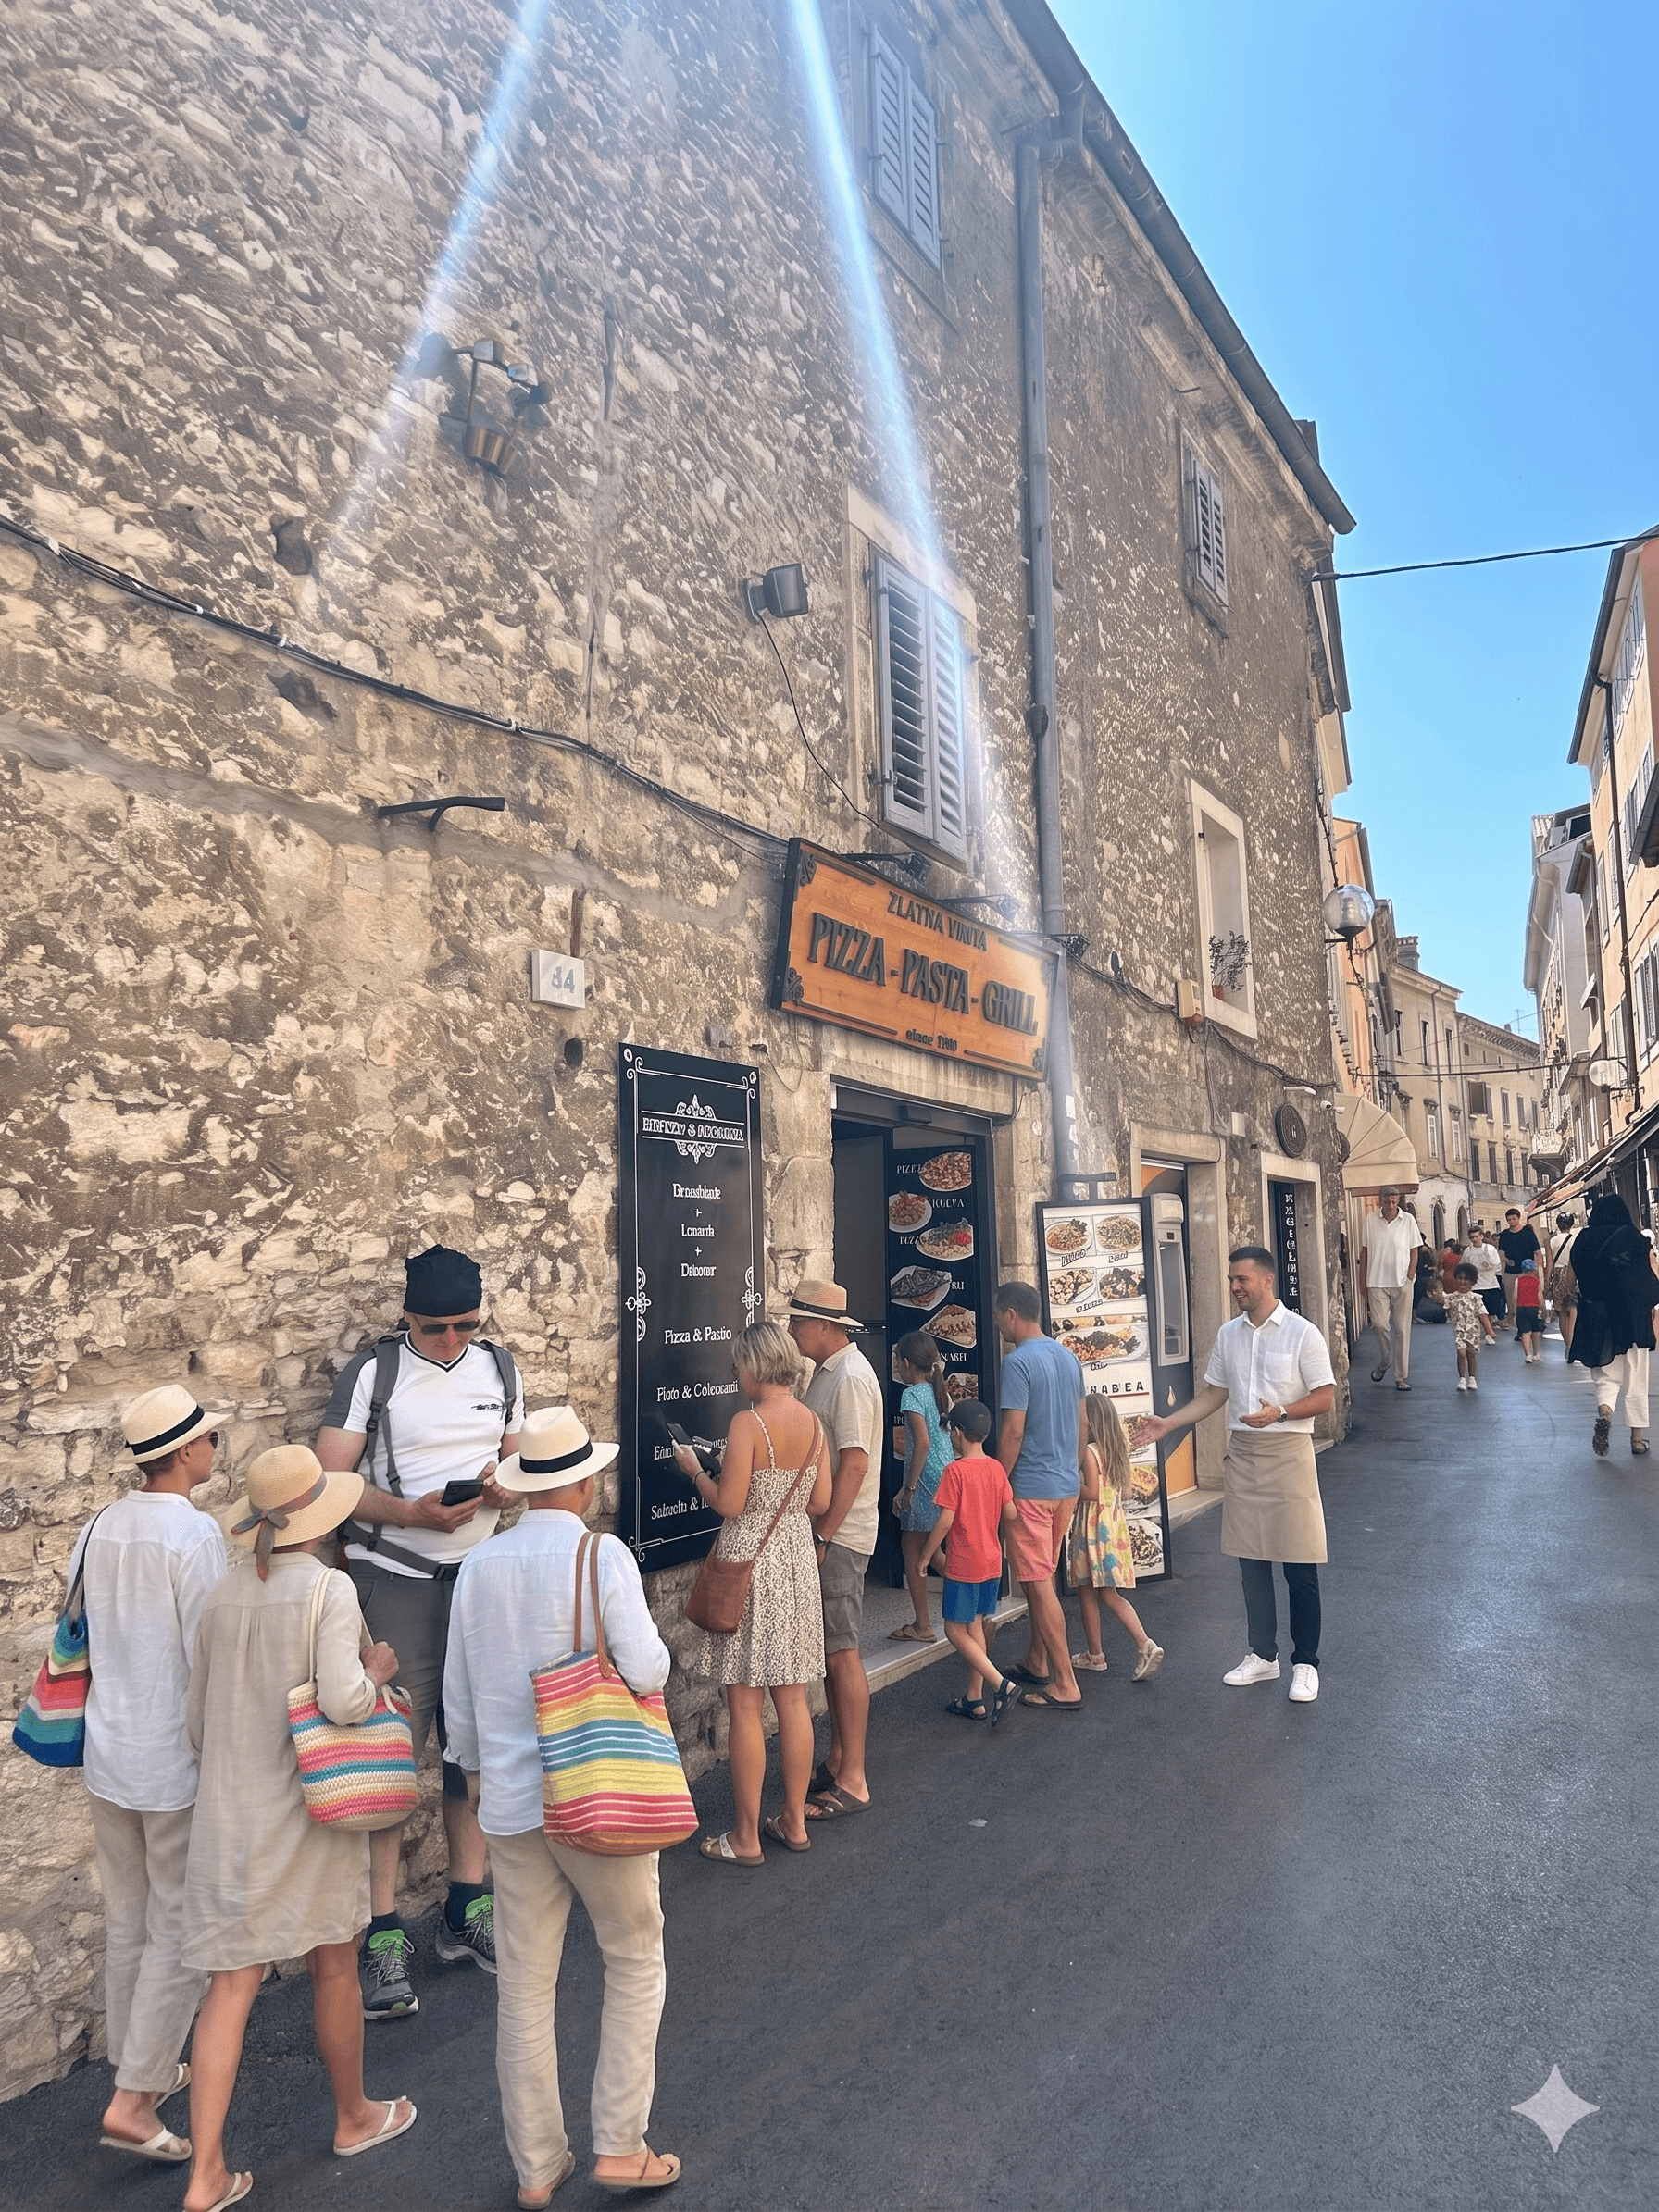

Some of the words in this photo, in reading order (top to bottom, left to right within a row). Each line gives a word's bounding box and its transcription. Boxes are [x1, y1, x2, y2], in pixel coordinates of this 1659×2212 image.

[887, 891, 944, 934] ZLATNA
[807, 912, 886, 987] PIZZA
[900, 948, 969, 1014] PASTA
[982, 979, 1039, 1036] GRILL
